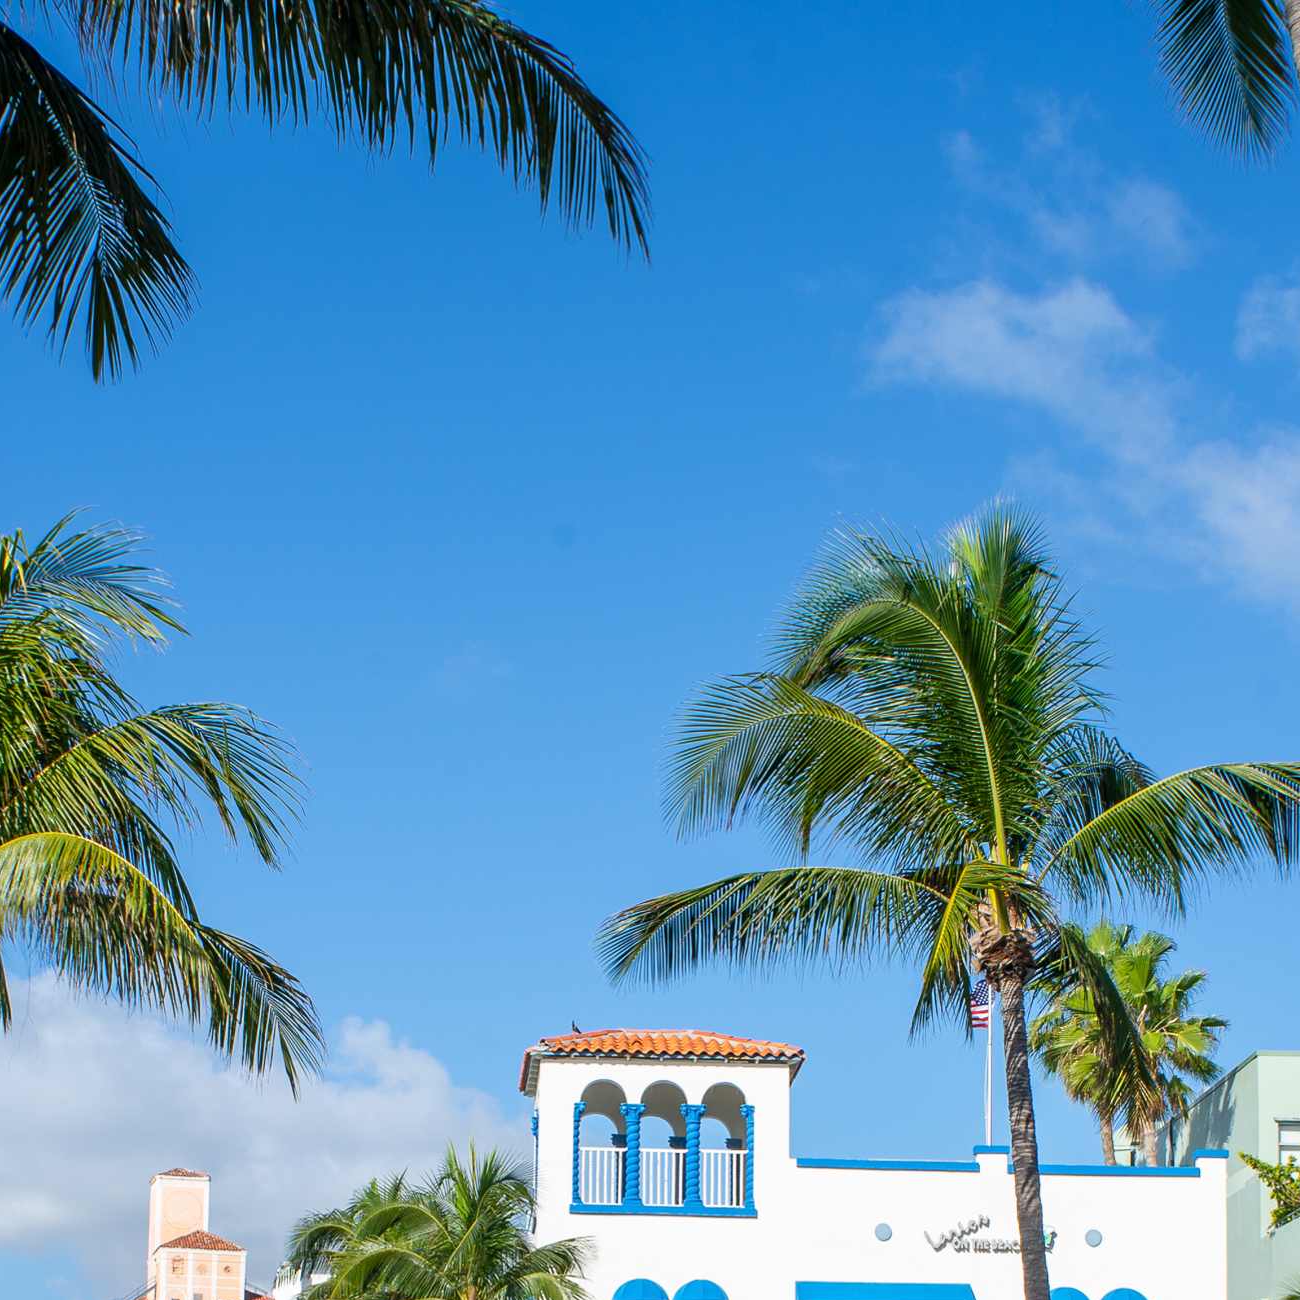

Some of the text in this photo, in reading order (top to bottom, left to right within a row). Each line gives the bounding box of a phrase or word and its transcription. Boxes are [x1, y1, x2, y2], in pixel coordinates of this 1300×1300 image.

[951, 1238, 1021, 1254] ON THE BEAC
